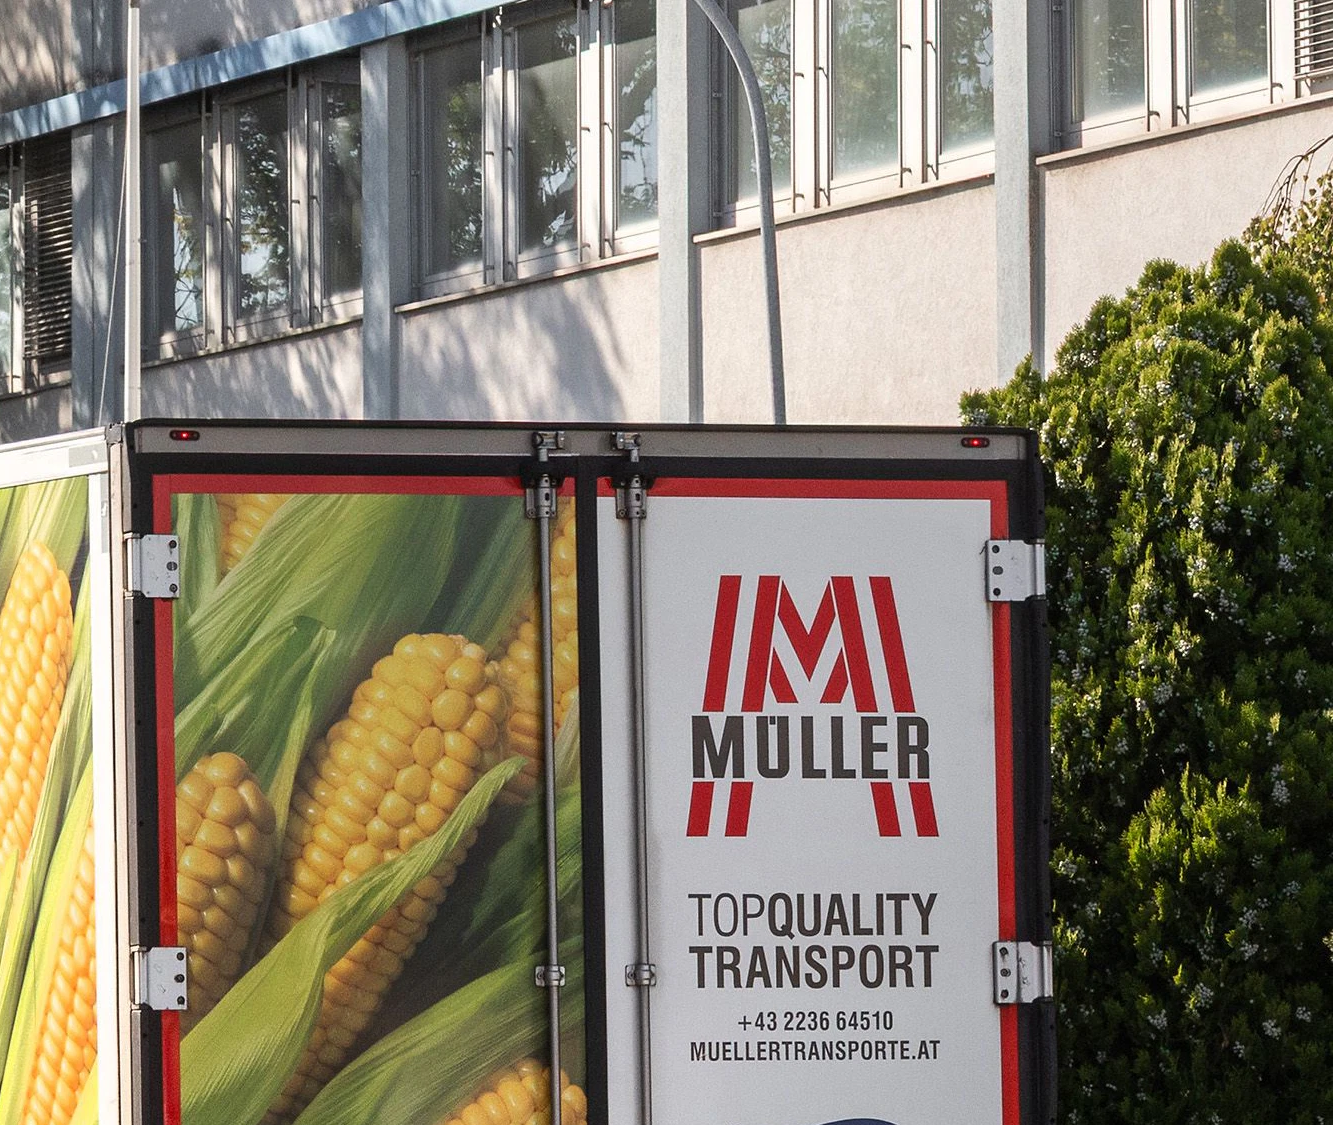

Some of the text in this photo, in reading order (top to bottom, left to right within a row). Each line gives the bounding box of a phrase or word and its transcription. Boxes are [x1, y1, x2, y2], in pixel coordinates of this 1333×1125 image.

[691, 715, 930, 779] MÜLLER
[688, 893, 938, 940] TOPQUALITY
[689, 945, 940, 989] TRANSPORT
[737, 1010, 894, 1032] +43 2236 64510
[690, 1039, 941, 1062] MUELLERTRANSPORTE.AT
